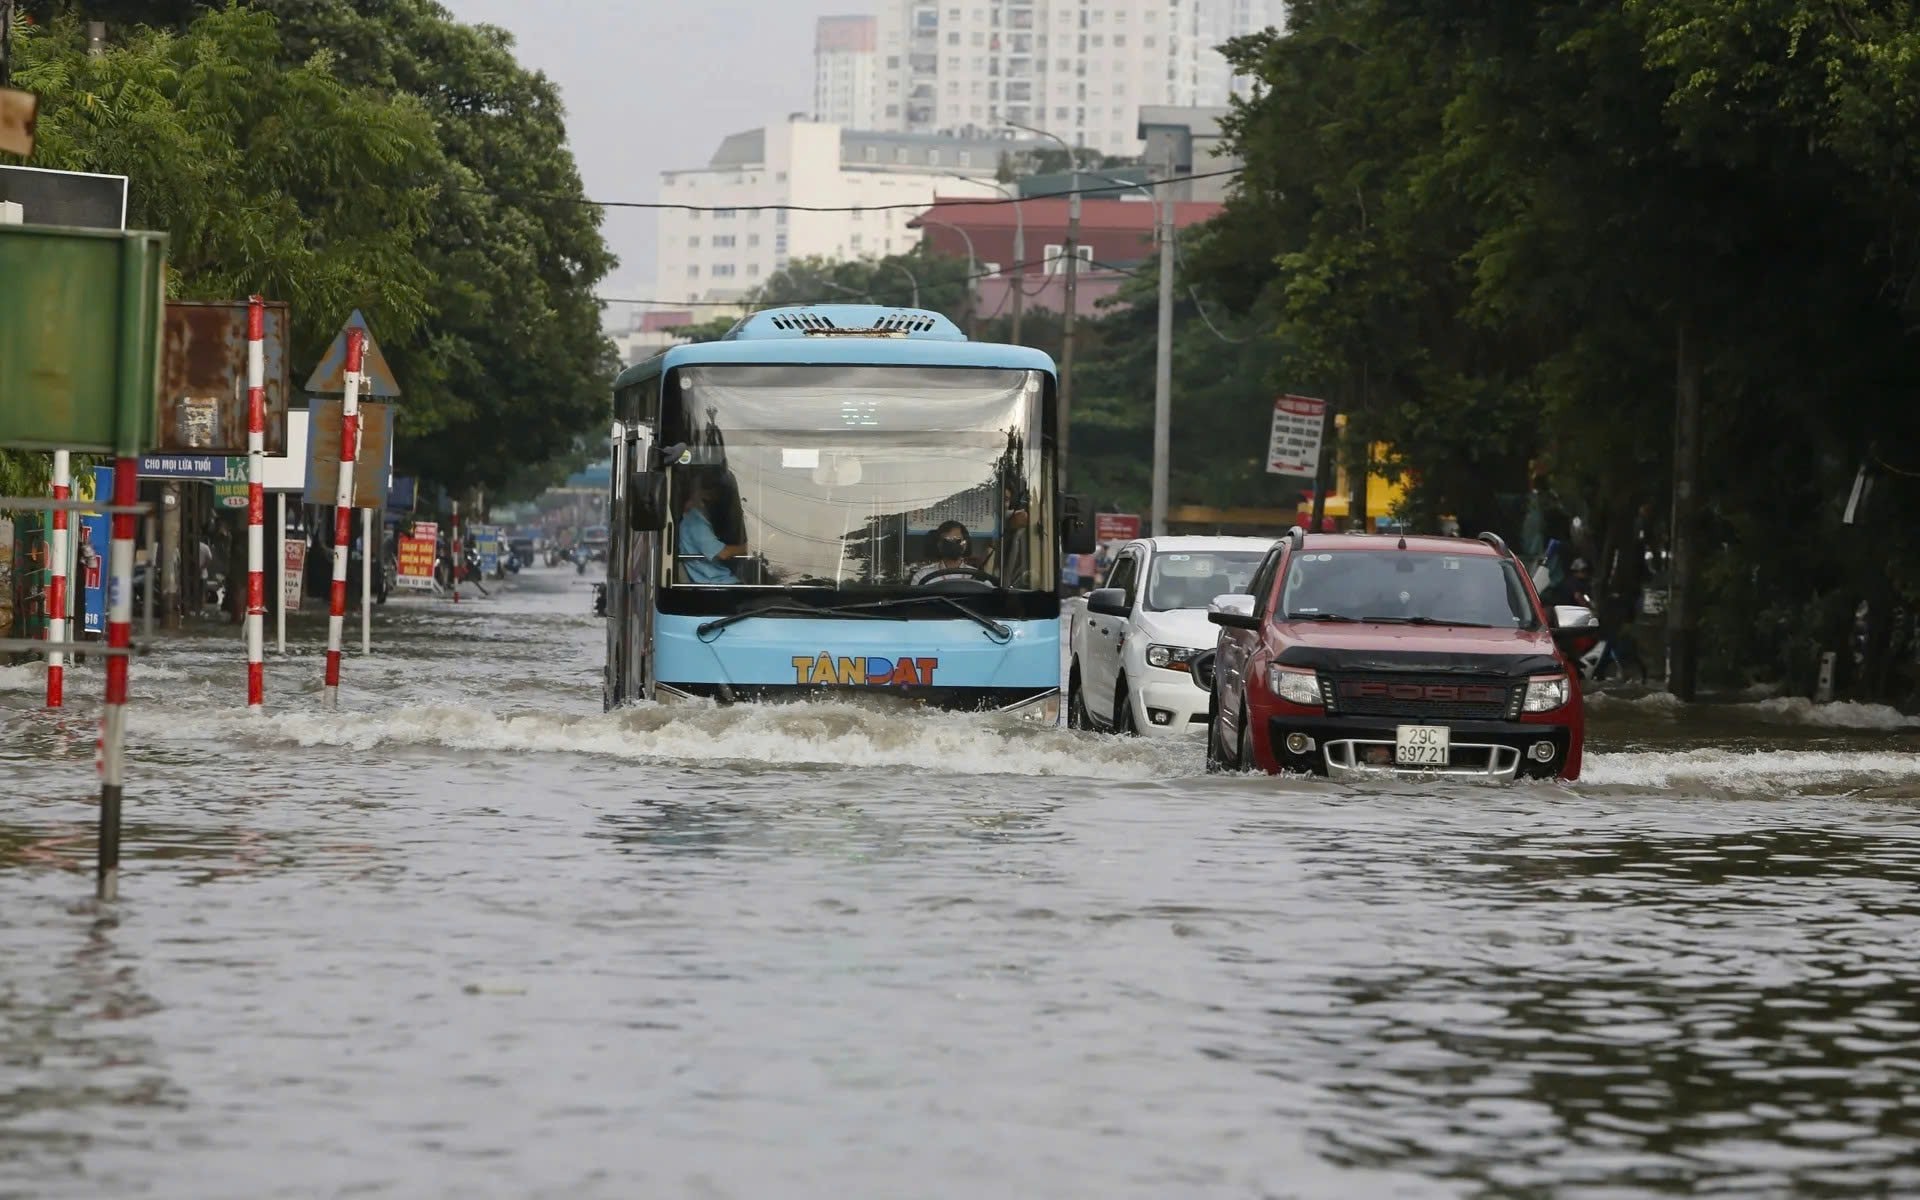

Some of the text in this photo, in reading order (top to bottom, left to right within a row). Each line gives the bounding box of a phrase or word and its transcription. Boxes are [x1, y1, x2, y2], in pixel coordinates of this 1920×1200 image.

[145, 456, 212, 473] CHO MỌI LỬA TUỔI
[1409, 728, 1438, 745] 29C
[1398, 745, 1446, 763] 397.21
